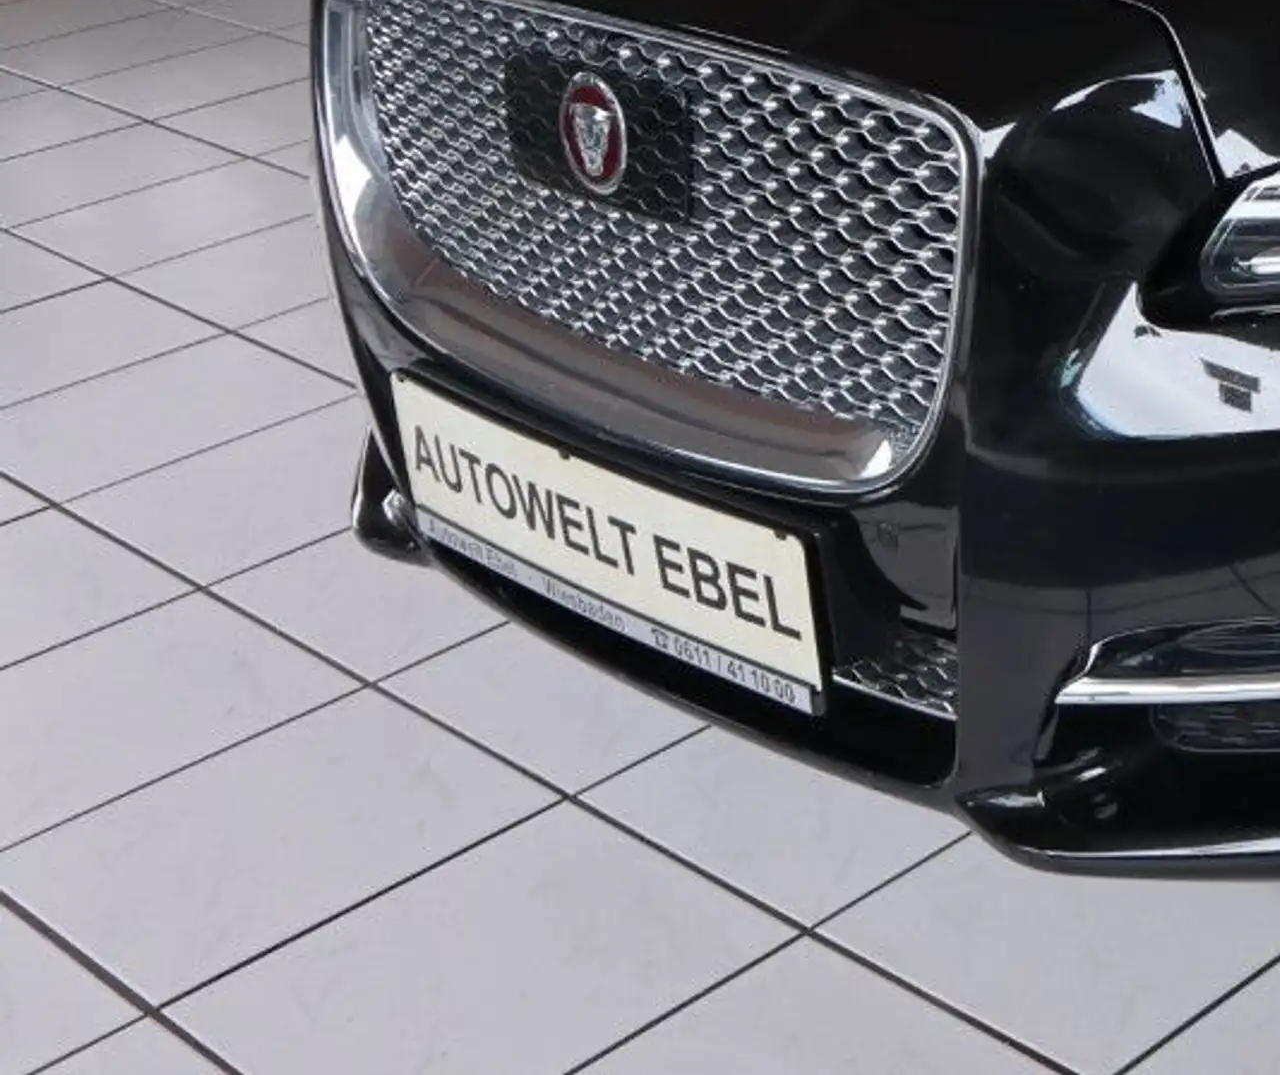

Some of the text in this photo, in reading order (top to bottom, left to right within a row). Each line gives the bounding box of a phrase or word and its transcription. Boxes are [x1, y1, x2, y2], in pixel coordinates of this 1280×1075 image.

[414, 425, 802, 641] AUTOWELT EBEL
[673, 632, 713, 670] 0611
[727, 659, 746, 682] 41
